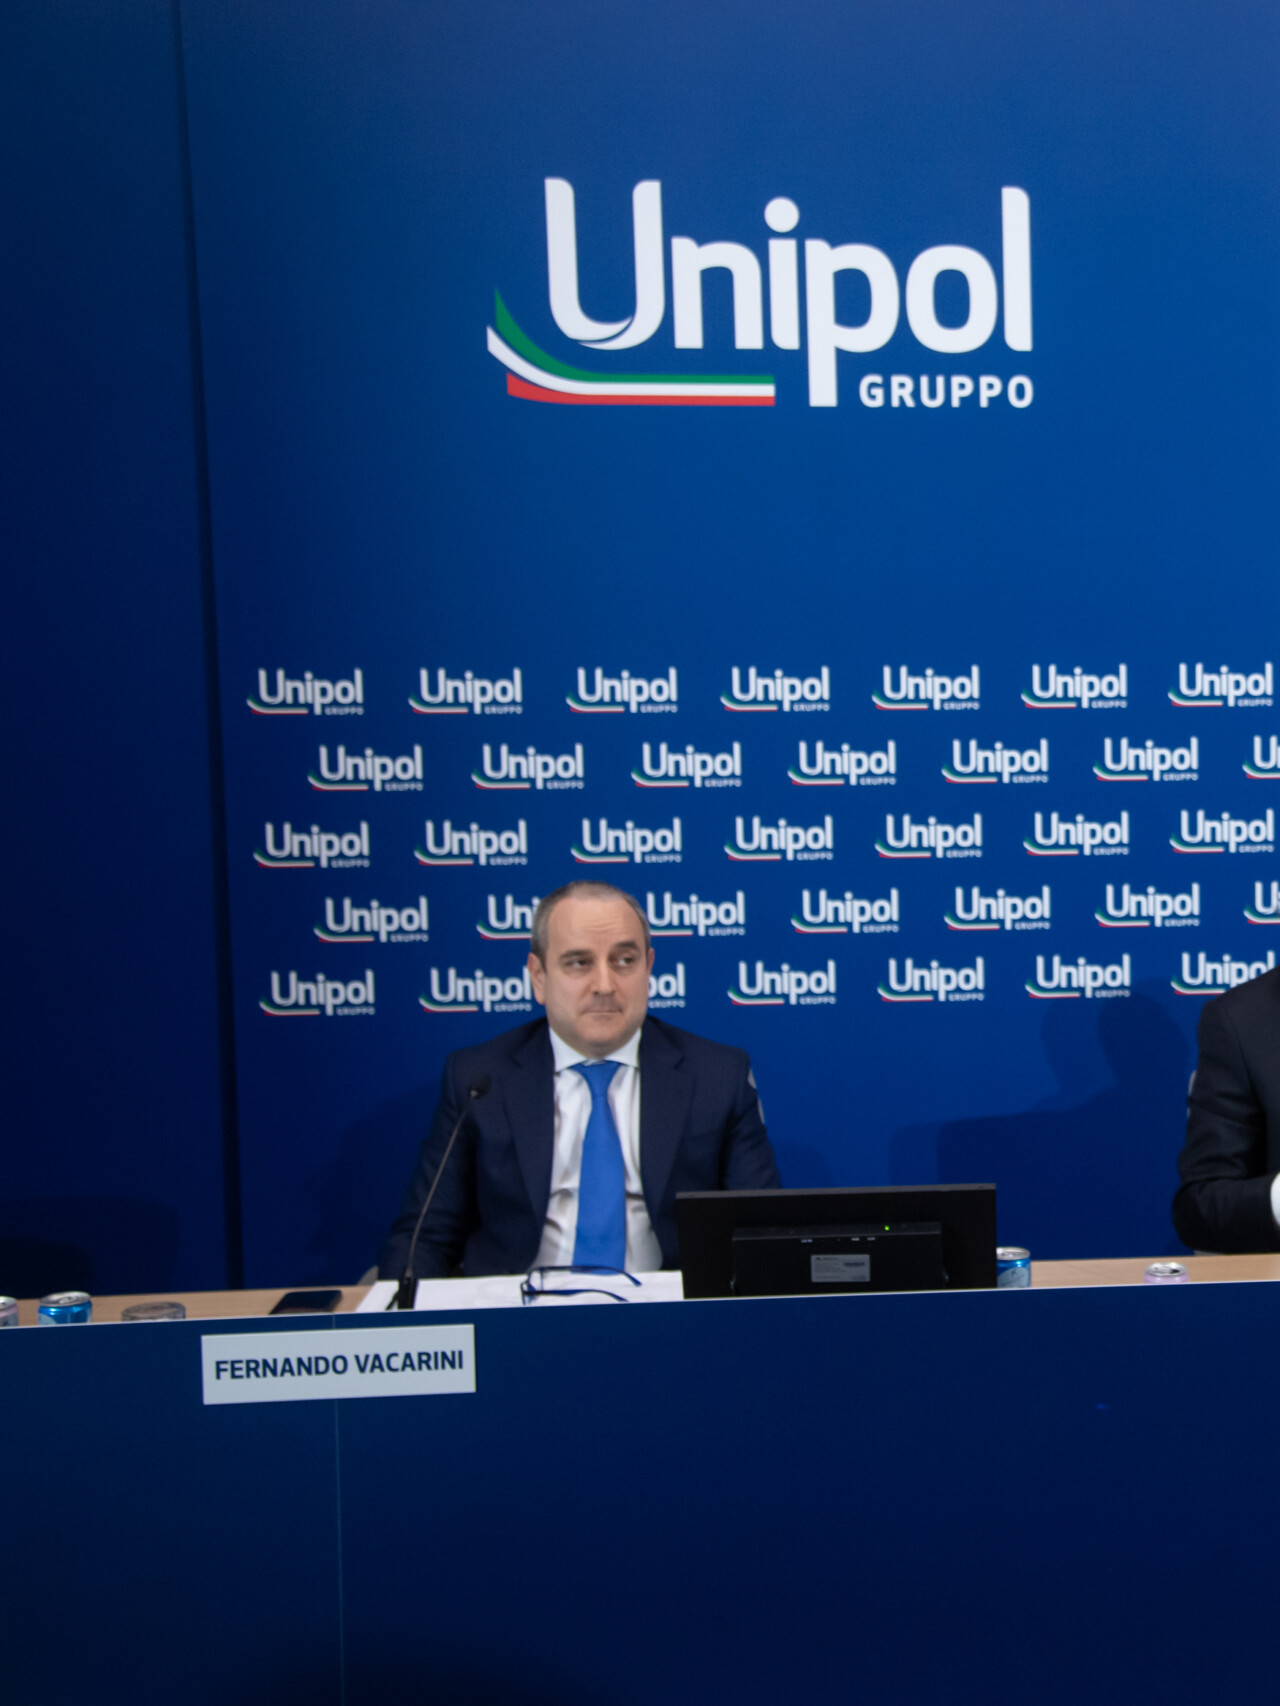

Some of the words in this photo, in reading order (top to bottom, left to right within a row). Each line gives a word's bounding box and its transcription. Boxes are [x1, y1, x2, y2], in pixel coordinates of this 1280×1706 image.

[544, 177, 1033, 407] Unipol
[858, 374, 1034, 408] GRUPPO
[259, 668, 364, 715] Unipol
[420, 667, 523, 714] Unipol
[577, 666, 678, 713] Unipol
[731, 665, 830, 712] Unipol
[883, 664, 980, 711] Unipol
[1032, 663, 1128, 709] Unipol
[1178, 662, 1273, 707] Unipol
[320, 744, 423, 791] Unipol
[482, 743, 584, 790] Unipol
[642, 741, 742, 788] Unipol
[798, 740, 896, 786] Unipol
[952, 738, 1049, 784] Unipol
[1104, 736, 1199, 782] Unipol
[265, 821, 370, 868] Unipol
[425, 819, 528, 866] Unipol
[582, 817, 682, 864] Unipol
[735, 815, 833, 861] Unipol
[886, 812, 983, 859] Unipol
[1034, 810, 1129, 856] Unipol
[1180, 808, 1274, 854] Unipol
[325, 896, 428, 942] Unipol
[647, 890, 745, 937] Unipol
[802, 888, 899, 934] Unipol
[955, 885, 1051, 931] Unipol
[1106, 882, 1200, 928] Unipol
[271, 969, 375, 1016] Unipol
[430, 967, 532, 1013] Unipol
[738, 959, 836, 1006] Unipol
[888, 956, 985, 1002] Unipol
[1036, 953, 1131, 999] Unipol
[214, 1354, 349, 1381] FERNANDO
[353, 1349, 464, 1374] VACARINI
